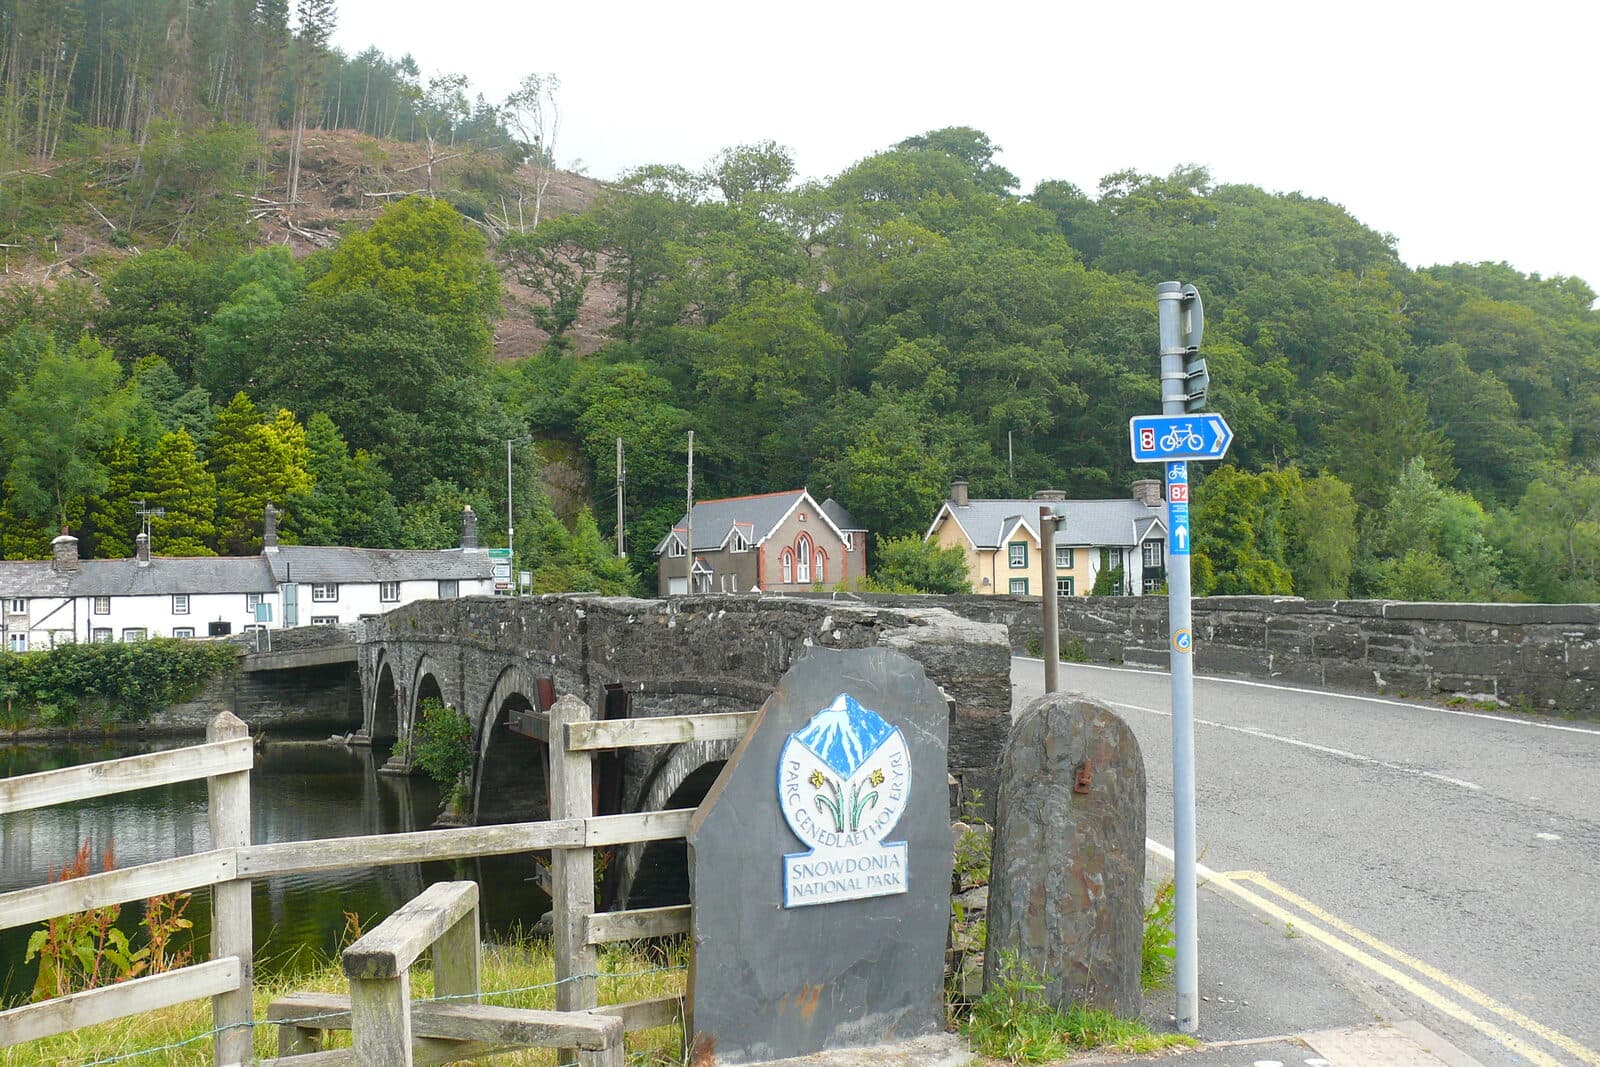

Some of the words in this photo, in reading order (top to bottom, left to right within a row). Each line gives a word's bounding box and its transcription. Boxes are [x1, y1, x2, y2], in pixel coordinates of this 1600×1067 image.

[1142, 431, 1154, 449] 8
[1171, 487, 1188, 499] 82
[786, 760, 801, 806] PARC
[795, 807, 896, 848] CENEDLAETHOL
[889, 751, 904, 801] ERYRI
[792, 853, 901, 880] SNOWDONIA
[792, 878, 863, 897] NATIONAL
[867, 873, 901, 889] PARK
